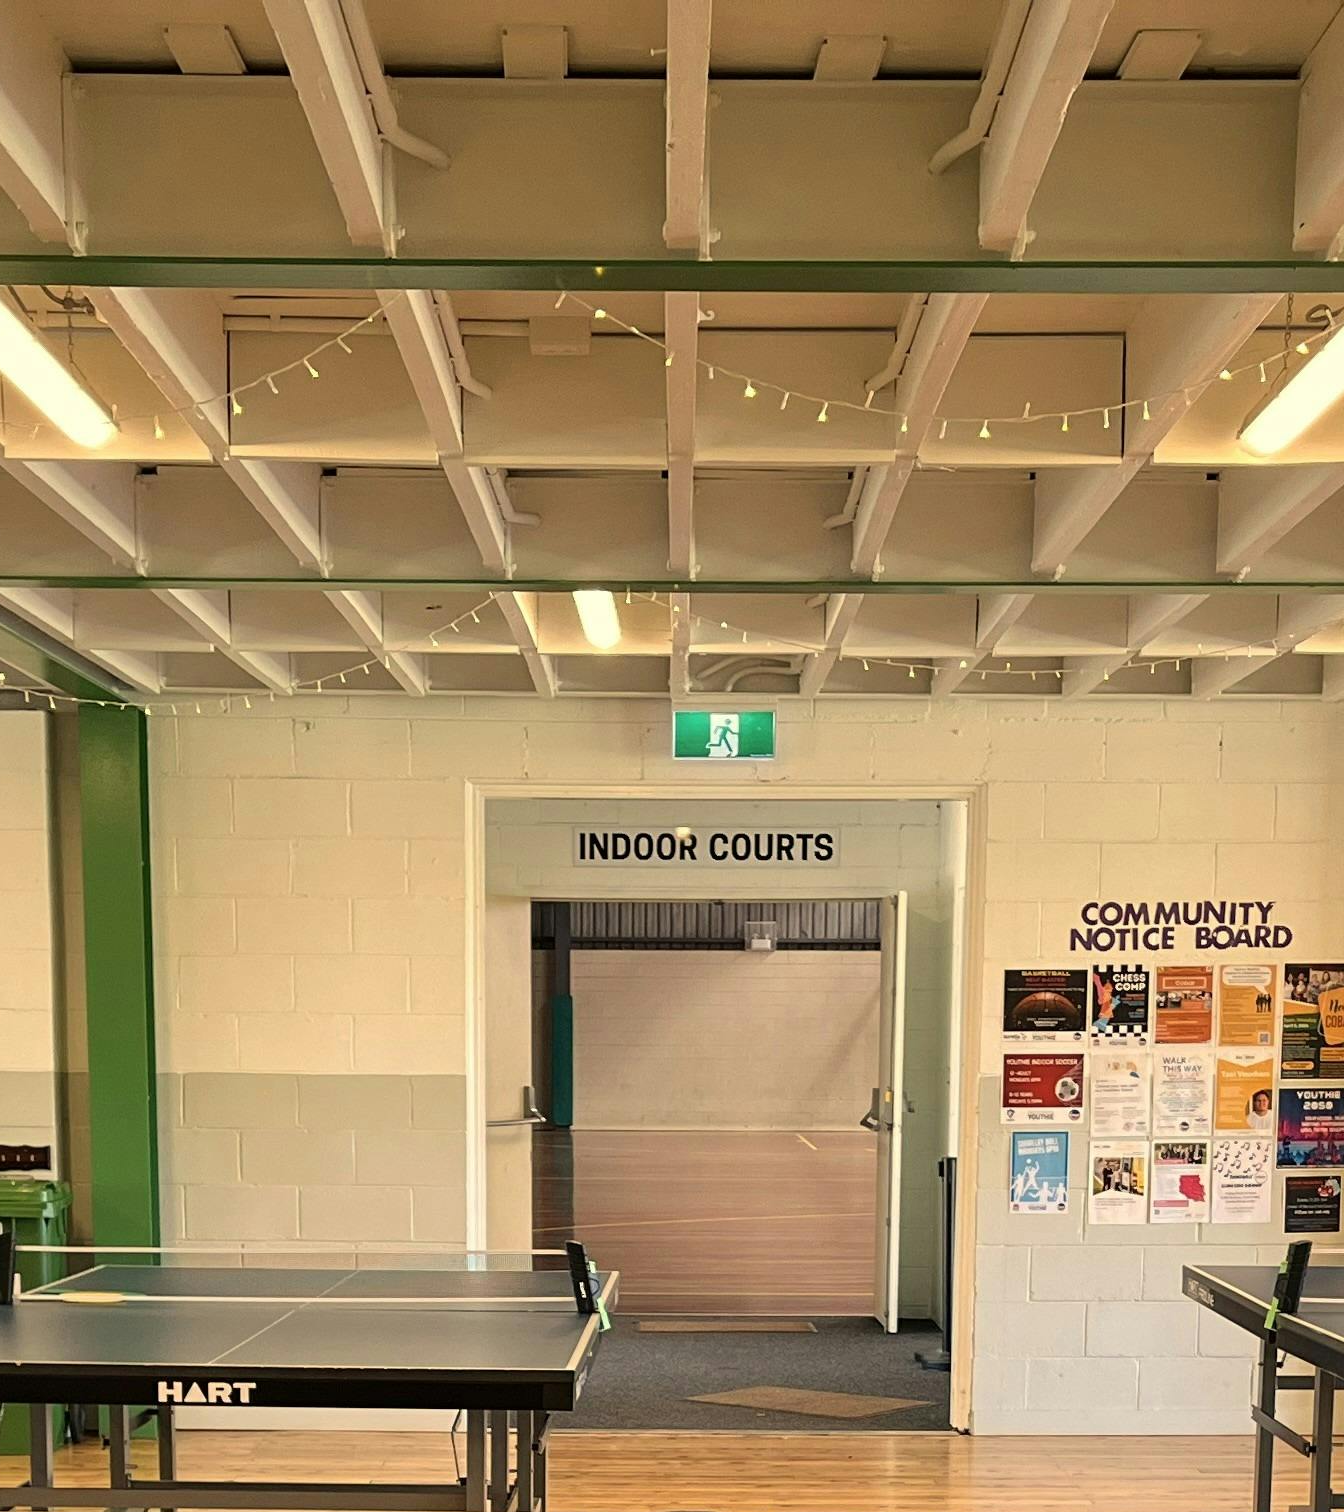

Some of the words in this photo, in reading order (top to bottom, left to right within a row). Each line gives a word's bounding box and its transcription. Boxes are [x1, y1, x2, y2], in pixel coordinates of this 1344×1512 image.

[579, 832, 697, 861] INDOOR
[709, 832, 834, 861] COURTS
[1081, 900, 1277, 926] COMMUNITY
[1070, 926, 1175, 952] NOTICE
[1195, 925, 1293, 950] BOARD
[1112, 973, 1146, 983] CHESS
[1114, 983, 1146, 991] COMP
[1162, 1056, 1186, 1065] WALK
[1162, 1065, 1182, 1073] THIS
[1183, 1065, 1202, 1073] WAY
[1296, 1090, 1341, 1099] YOUTHIE
[157, 1381, 257, 1403] HART
